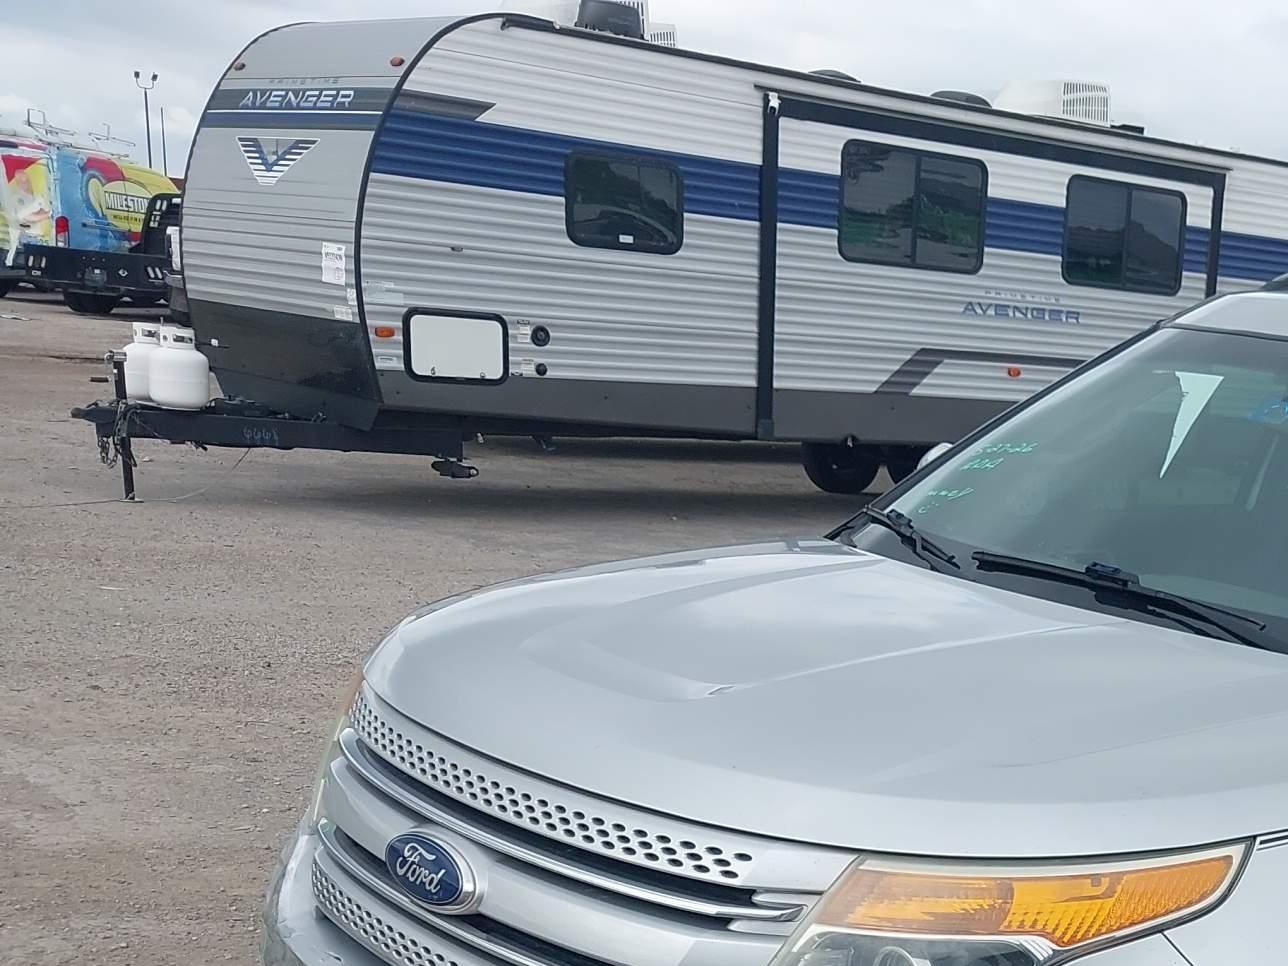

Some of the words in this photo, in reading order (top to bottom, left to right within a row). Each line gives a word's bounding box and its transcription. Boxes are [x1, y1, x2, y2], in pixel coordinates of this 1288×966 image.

[239, 91, 355, 108] AVENGER
[962, 301, 1080, 324] AVENGER
[396, 843, 446, 893] Ford
